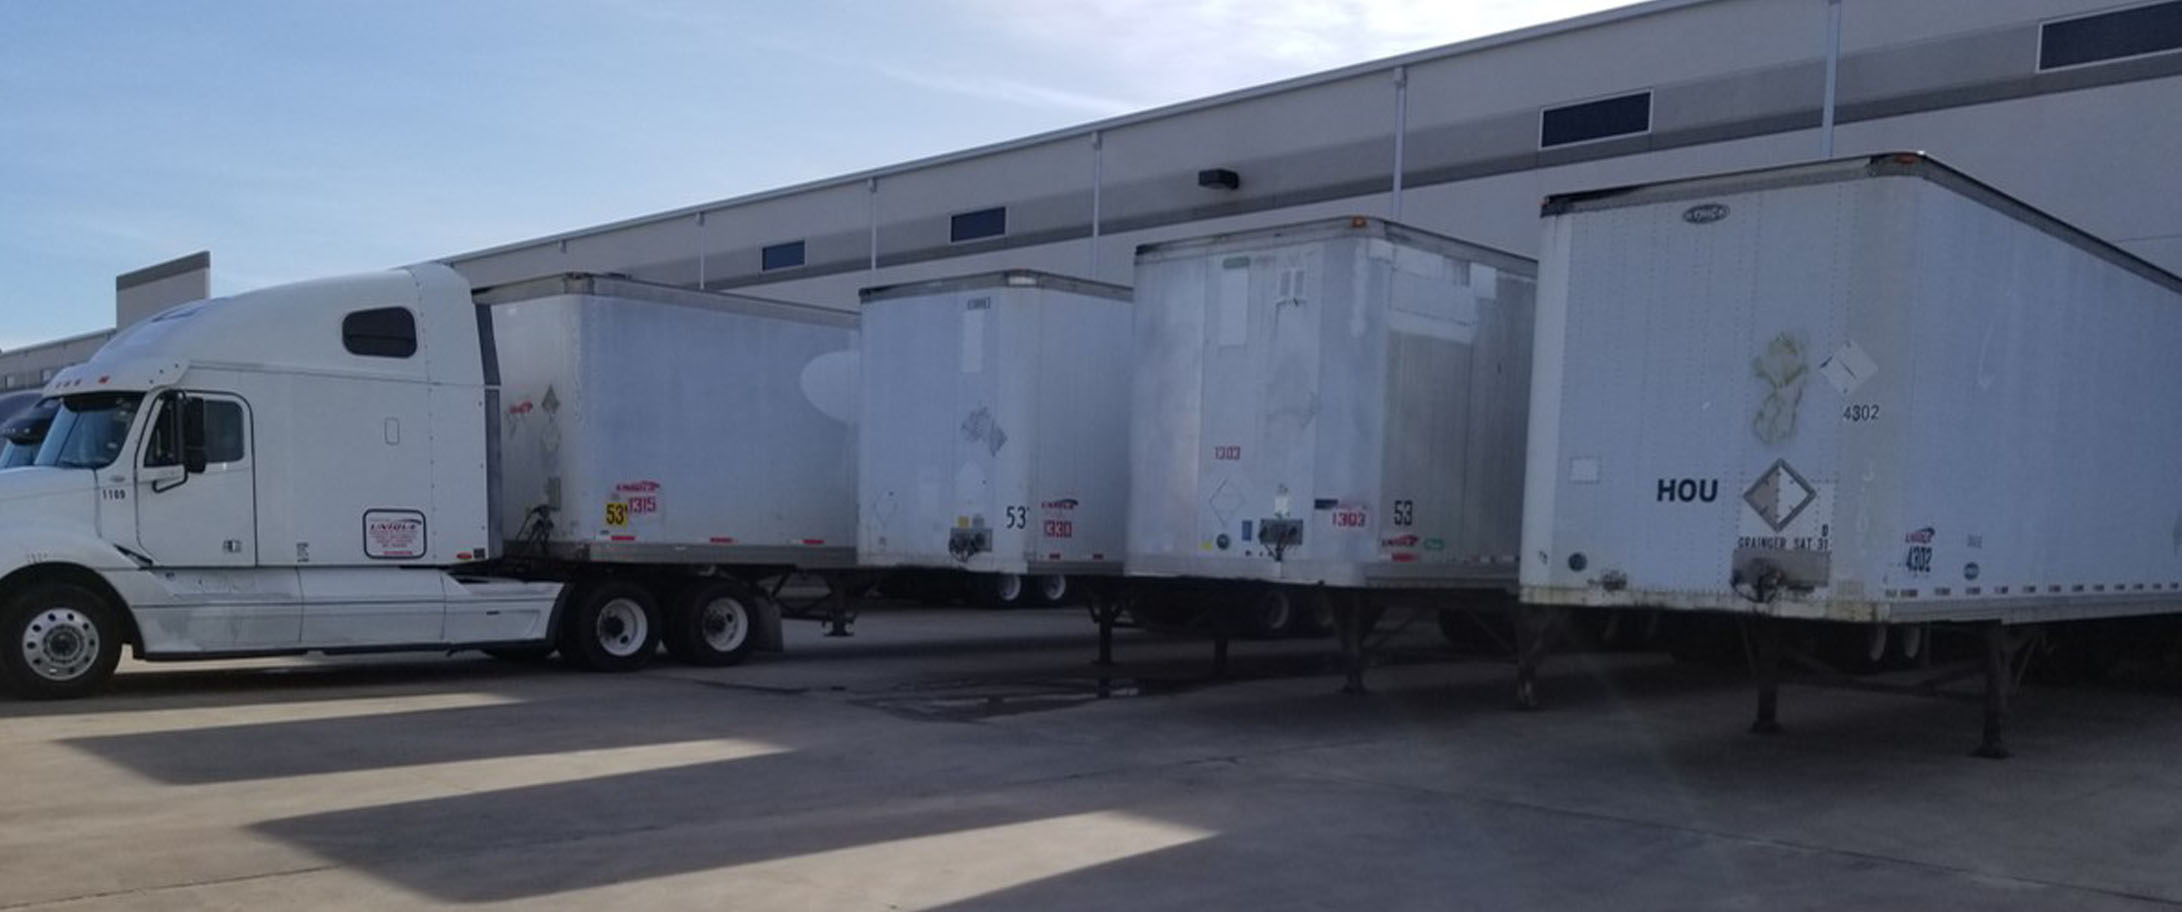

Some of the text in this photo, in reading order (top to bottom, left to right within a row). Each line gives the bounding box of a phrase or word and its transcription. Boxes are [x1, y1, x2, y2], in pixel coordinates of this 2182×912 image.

[1843, 404, 1880, 421] 4302
[1215, 446, 1241, 461] 1303
[1656, 478, 1718, 502] HOU
[629, 497, 656, 513] 1315
[1394, 499, 1412, 526] 53
[1332, 511, 1366, 527] 1303
[1044, 521, 1072, 537] 1330
[1793, 537, 1812, 551] SAT
[1906, 546, 1932, 572] 4302
